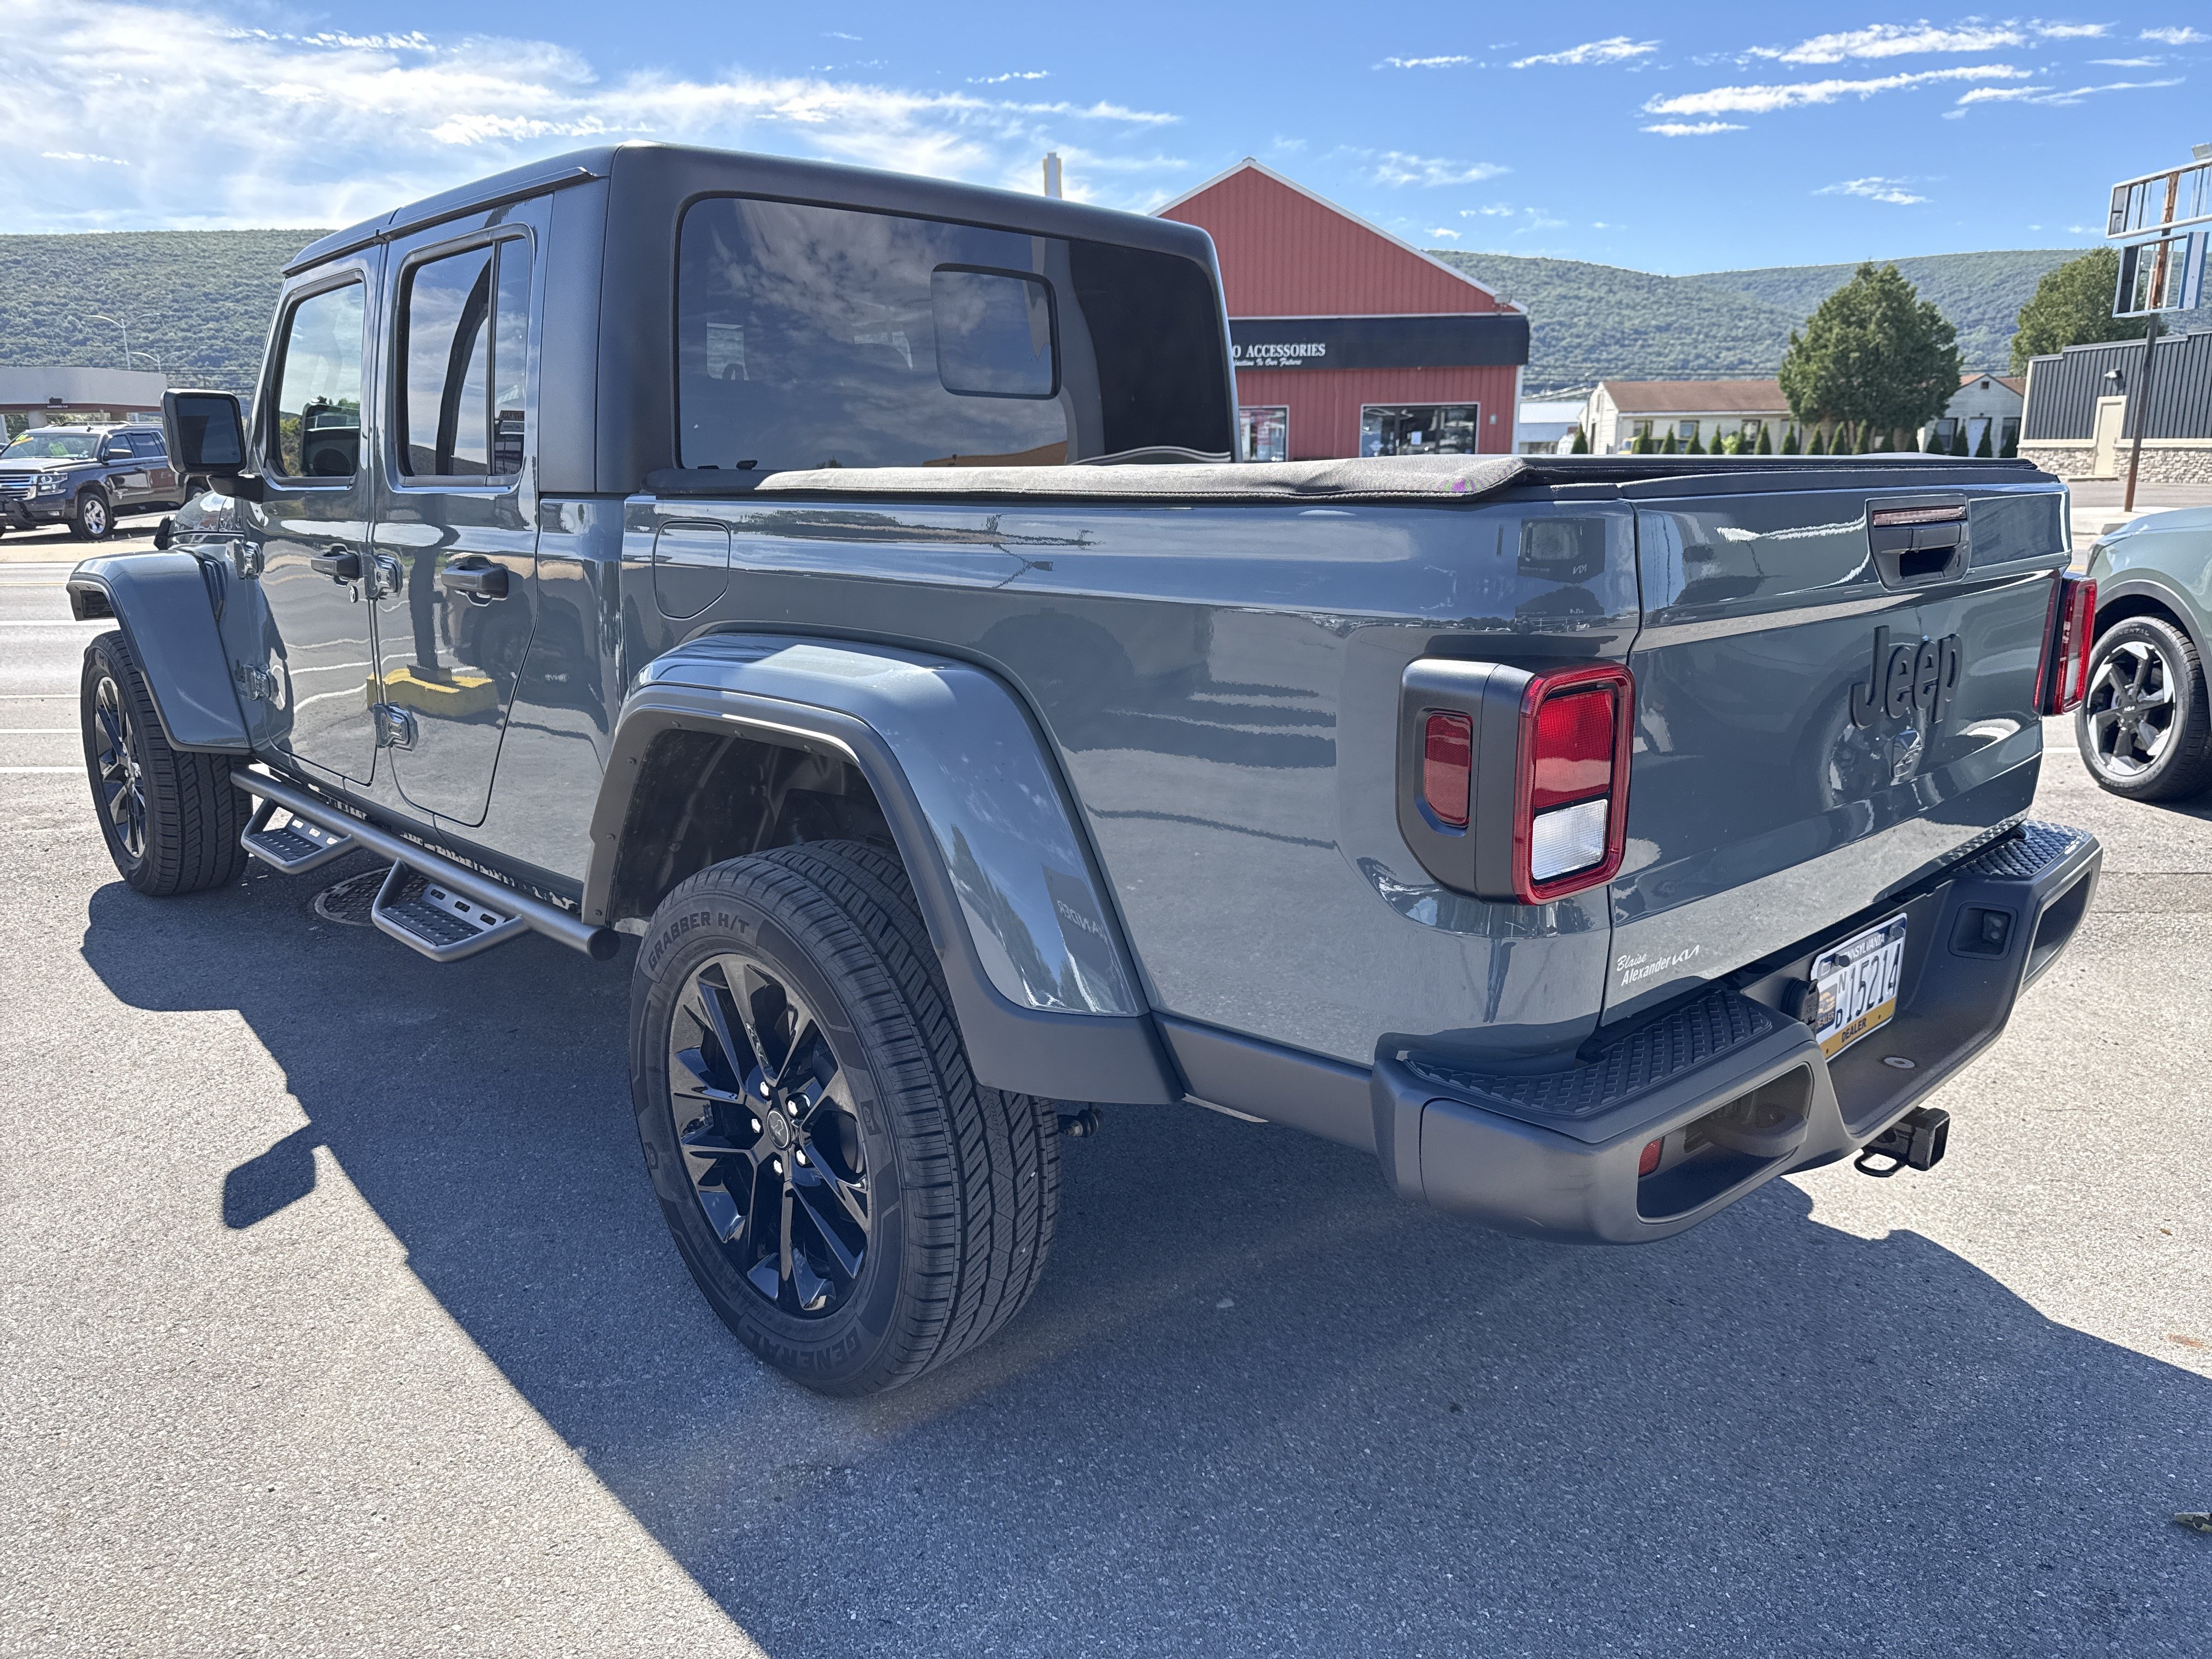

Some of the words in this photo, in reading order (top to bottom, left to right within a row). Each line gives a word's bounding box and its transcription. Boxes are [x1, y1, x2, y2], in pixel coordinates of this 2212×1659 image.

[1246, 342, 1326, 358] ACCESSORIES
[1848, 625, 1963, 730] Jeep
[648, 911, 711, 972] GRABBER
[718, 912, 750, 934] H/T
[1841, 933, 1884, 960] NNSYLVANIA
[1616, 953, 1647, 972] Blaise
[1621, 956, 1672, 986] Alexander
[1842, 1017, 1867, 1043] DEALER
[746, 1326, 863, 1372] GENERAL
